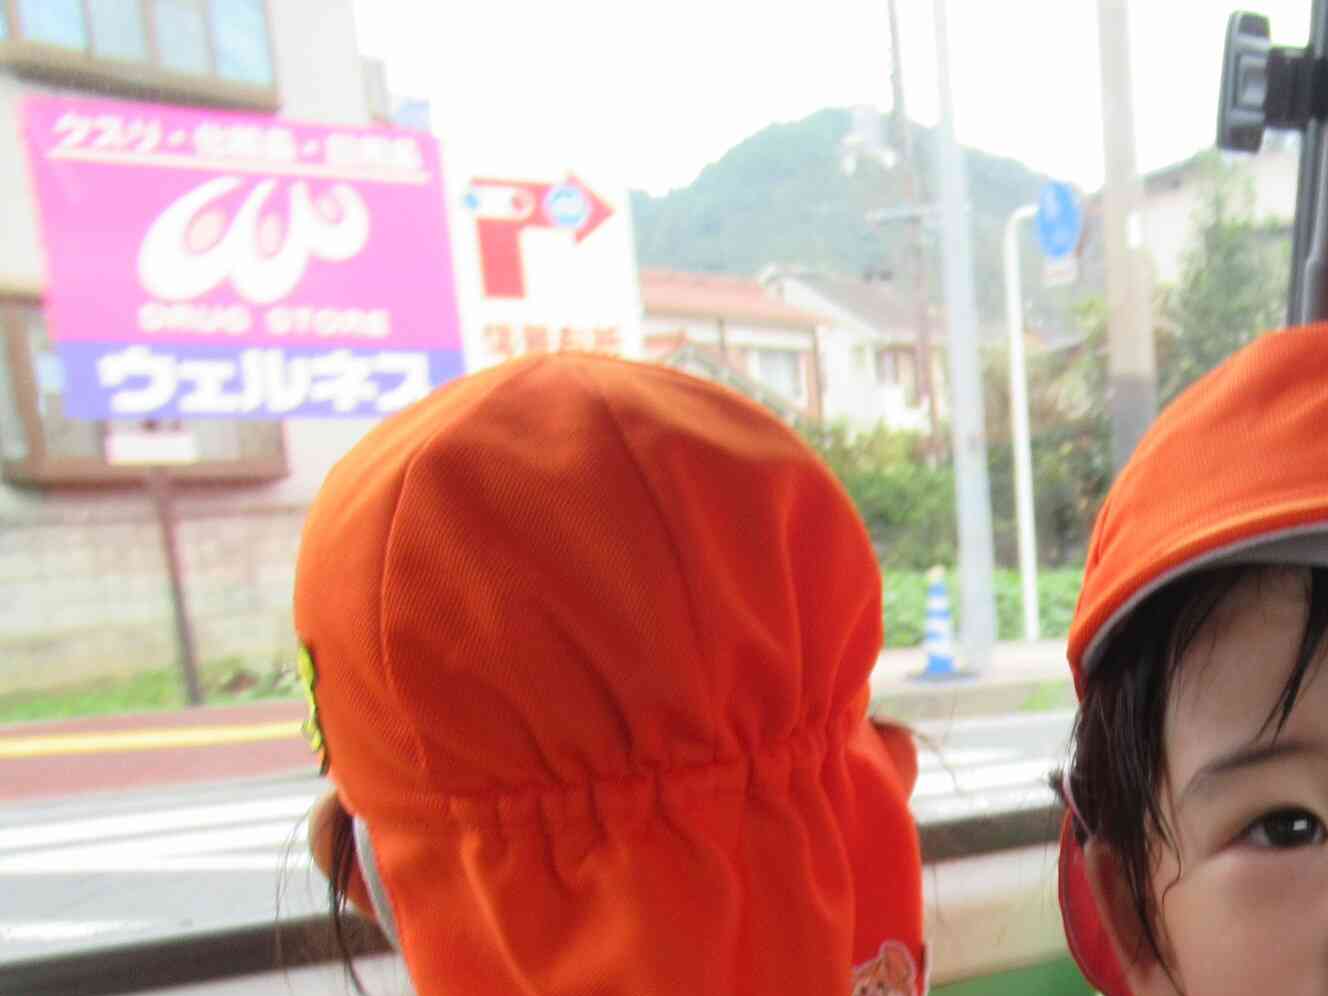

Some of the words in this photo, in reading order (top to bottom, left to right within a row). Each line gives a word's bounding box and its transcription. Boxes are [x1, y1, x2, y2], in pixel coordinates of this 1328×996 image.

[267, 306, 389, 338] STORE
[97, 345, 430, 413] ウェルネス
